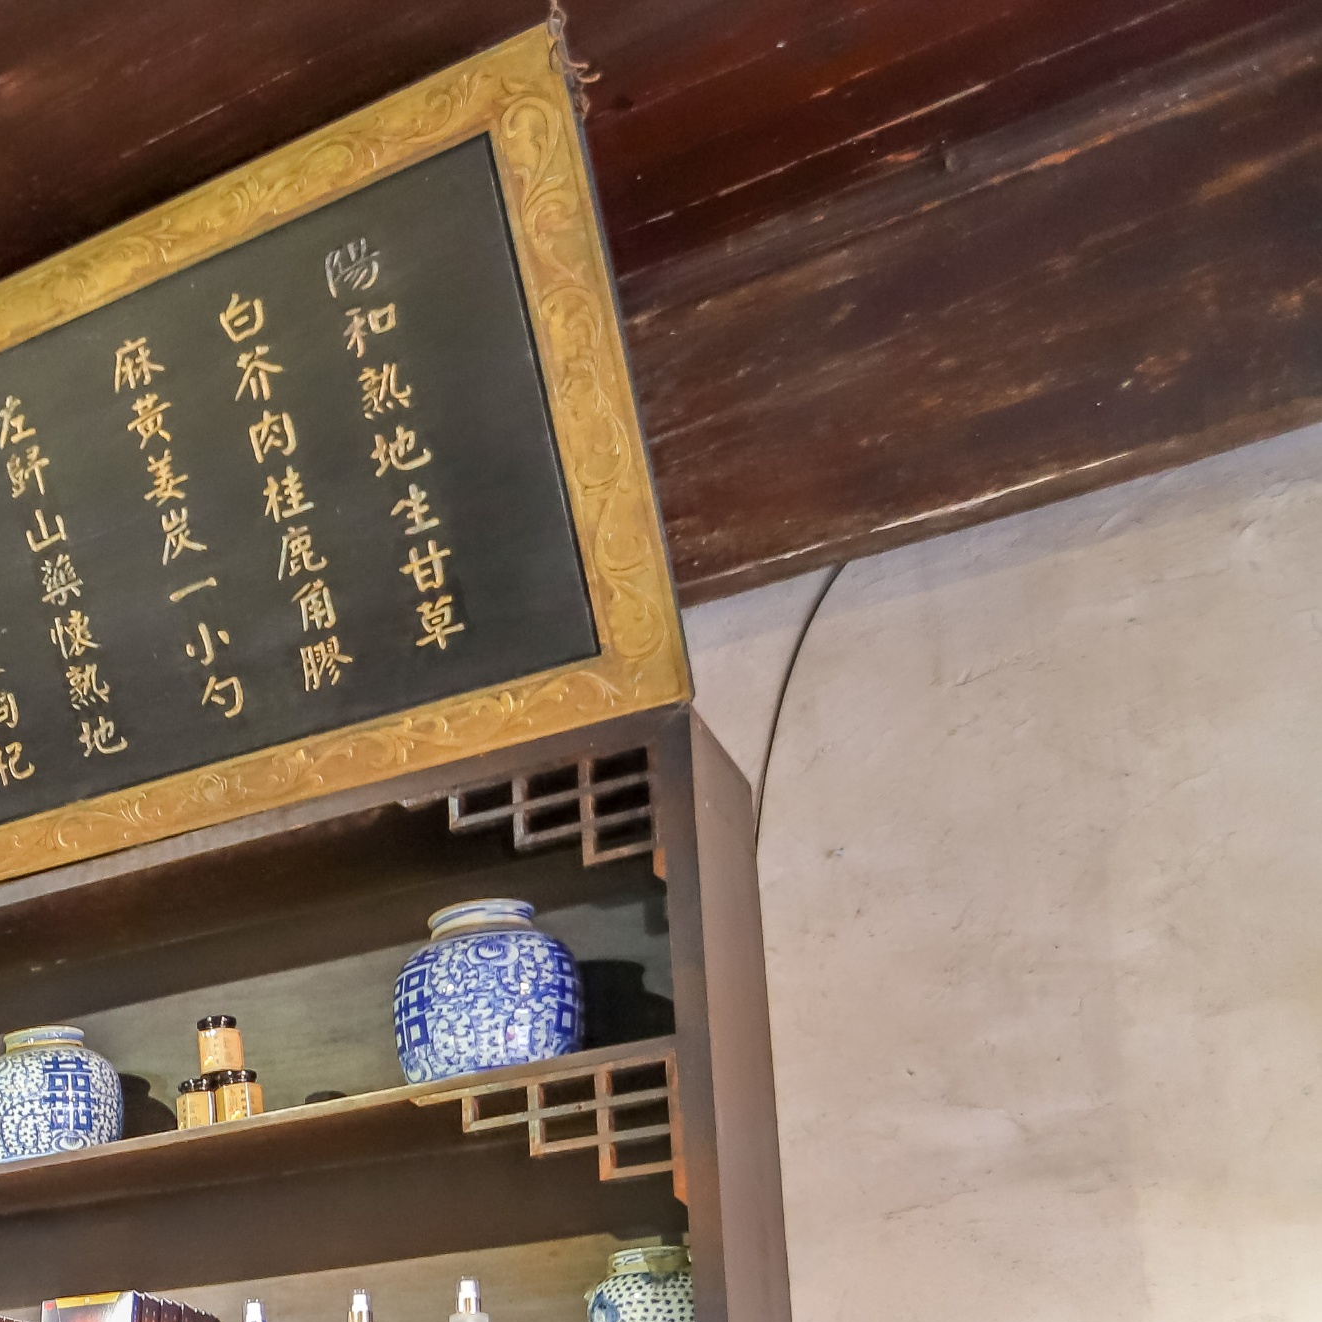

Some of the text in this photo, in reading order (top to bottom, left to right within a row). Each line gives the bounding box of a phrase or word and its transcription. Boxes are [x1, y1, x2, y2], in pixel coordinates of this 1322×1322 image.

[113, 335, 245, 719] 麻黃姜炭一小勺
[218, 292, 354, 693] 白芥肉桂鹿角膠
[324, 237, 466, 651] 陽和熟地生甘草
